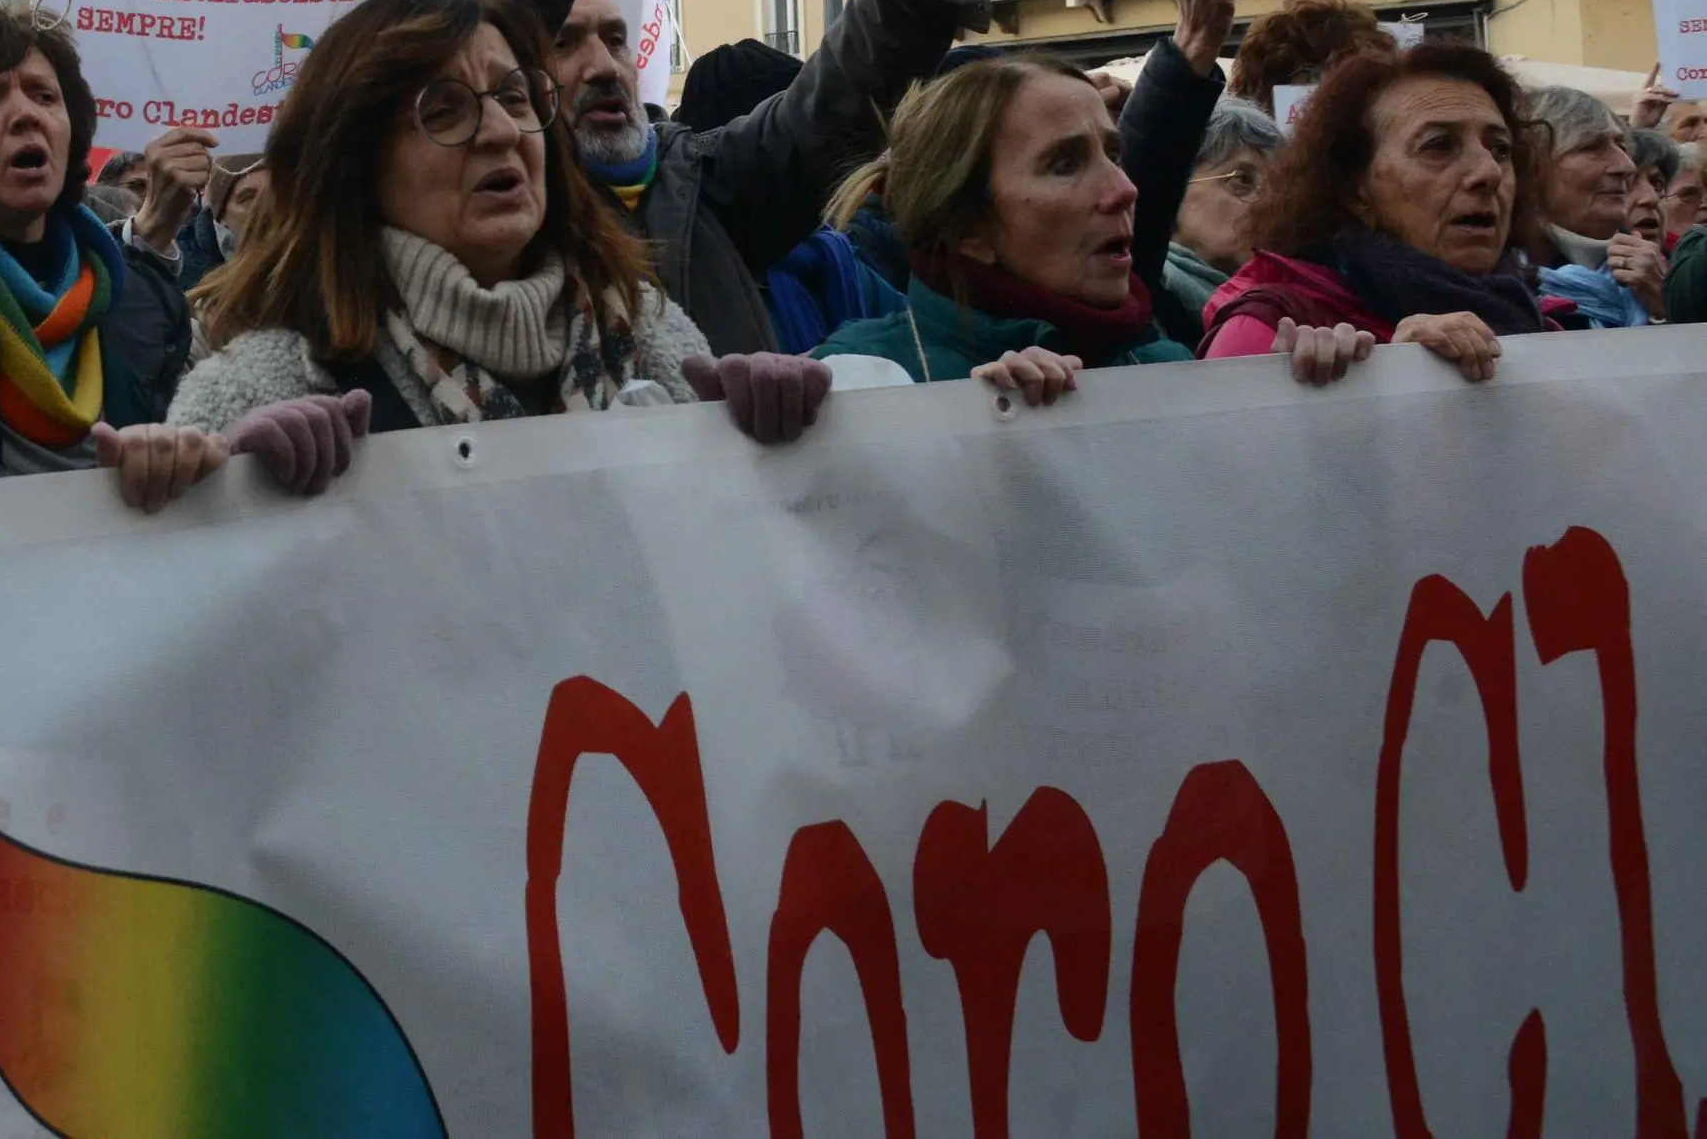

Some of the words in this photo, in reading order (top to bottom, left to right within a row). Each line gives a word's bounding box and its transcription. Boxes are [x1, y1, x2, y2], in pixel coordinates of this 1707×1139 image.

[78, 7, 206, 40] SEMPRE!
[252, 62, 301, 88] COR
[94, 97, 134, 120] ro
[143, 99, 285, 129] Clandes
